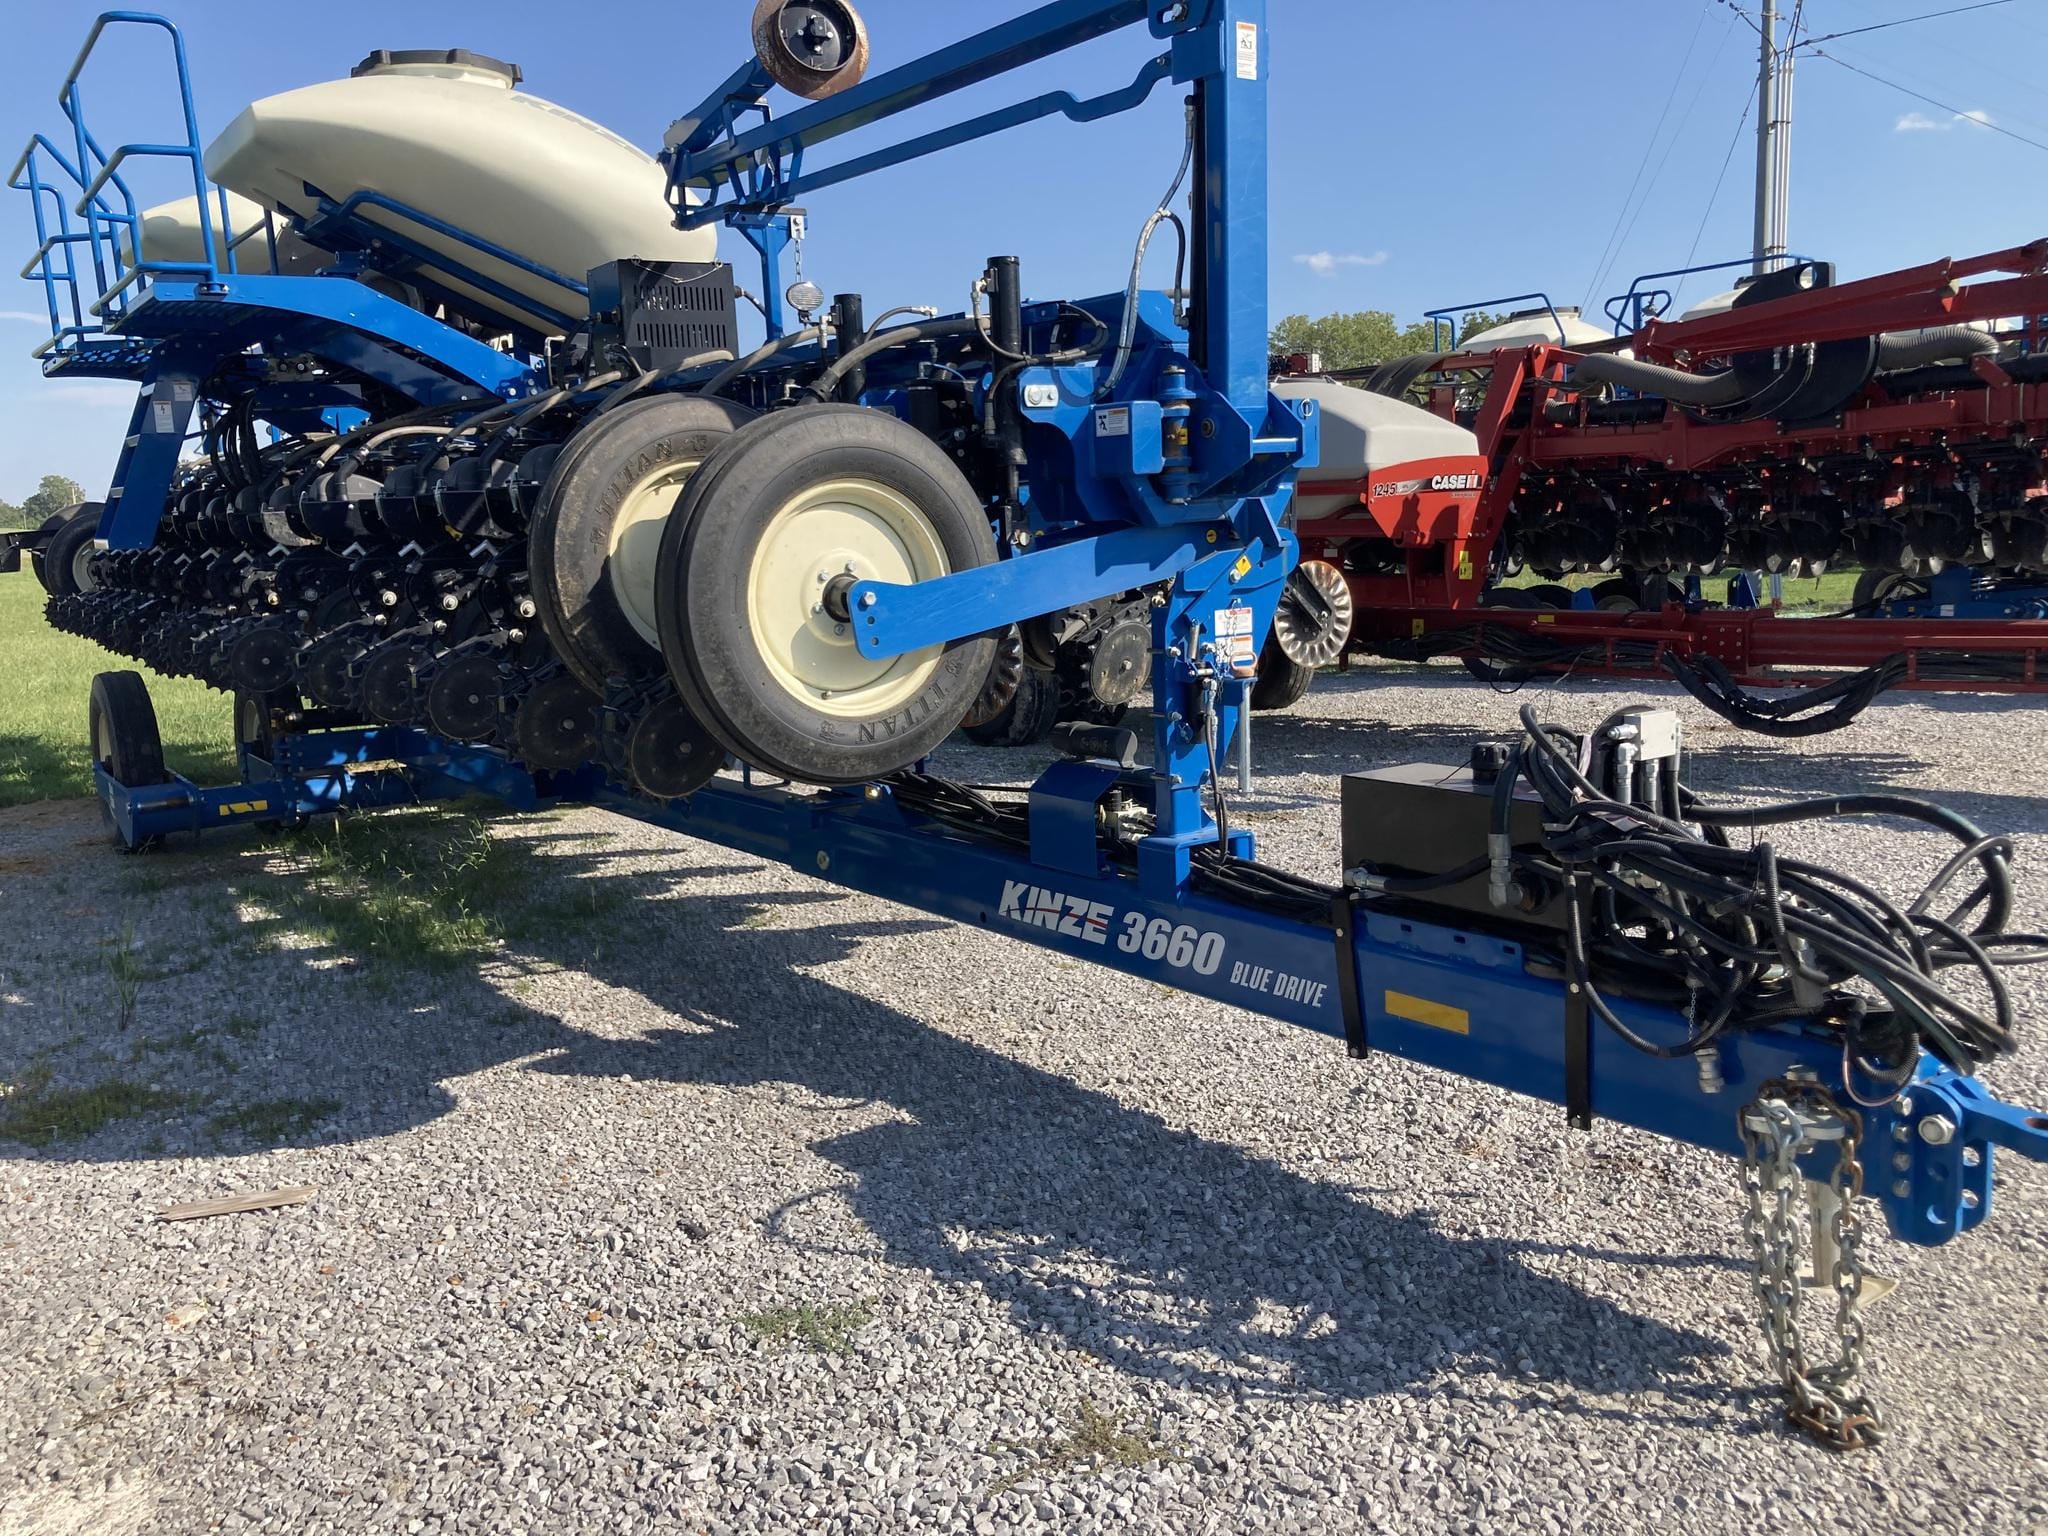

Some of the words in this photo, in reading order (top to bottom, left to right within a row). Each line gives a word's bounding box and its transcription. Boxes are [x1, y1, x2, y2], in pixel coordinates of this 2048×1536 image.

[595, 438, 674, 519] TITAN
[1373, 482, 1397, 497] 1245
[857, 679, 948, 744] TITAN
[998, 879, 1115, 945] KINZE
[1117, 912, 1226, 976] 3660
[1230, 961, 1274, 993] BLUE
[1273, 975, 1327, 1008] DRIVE
